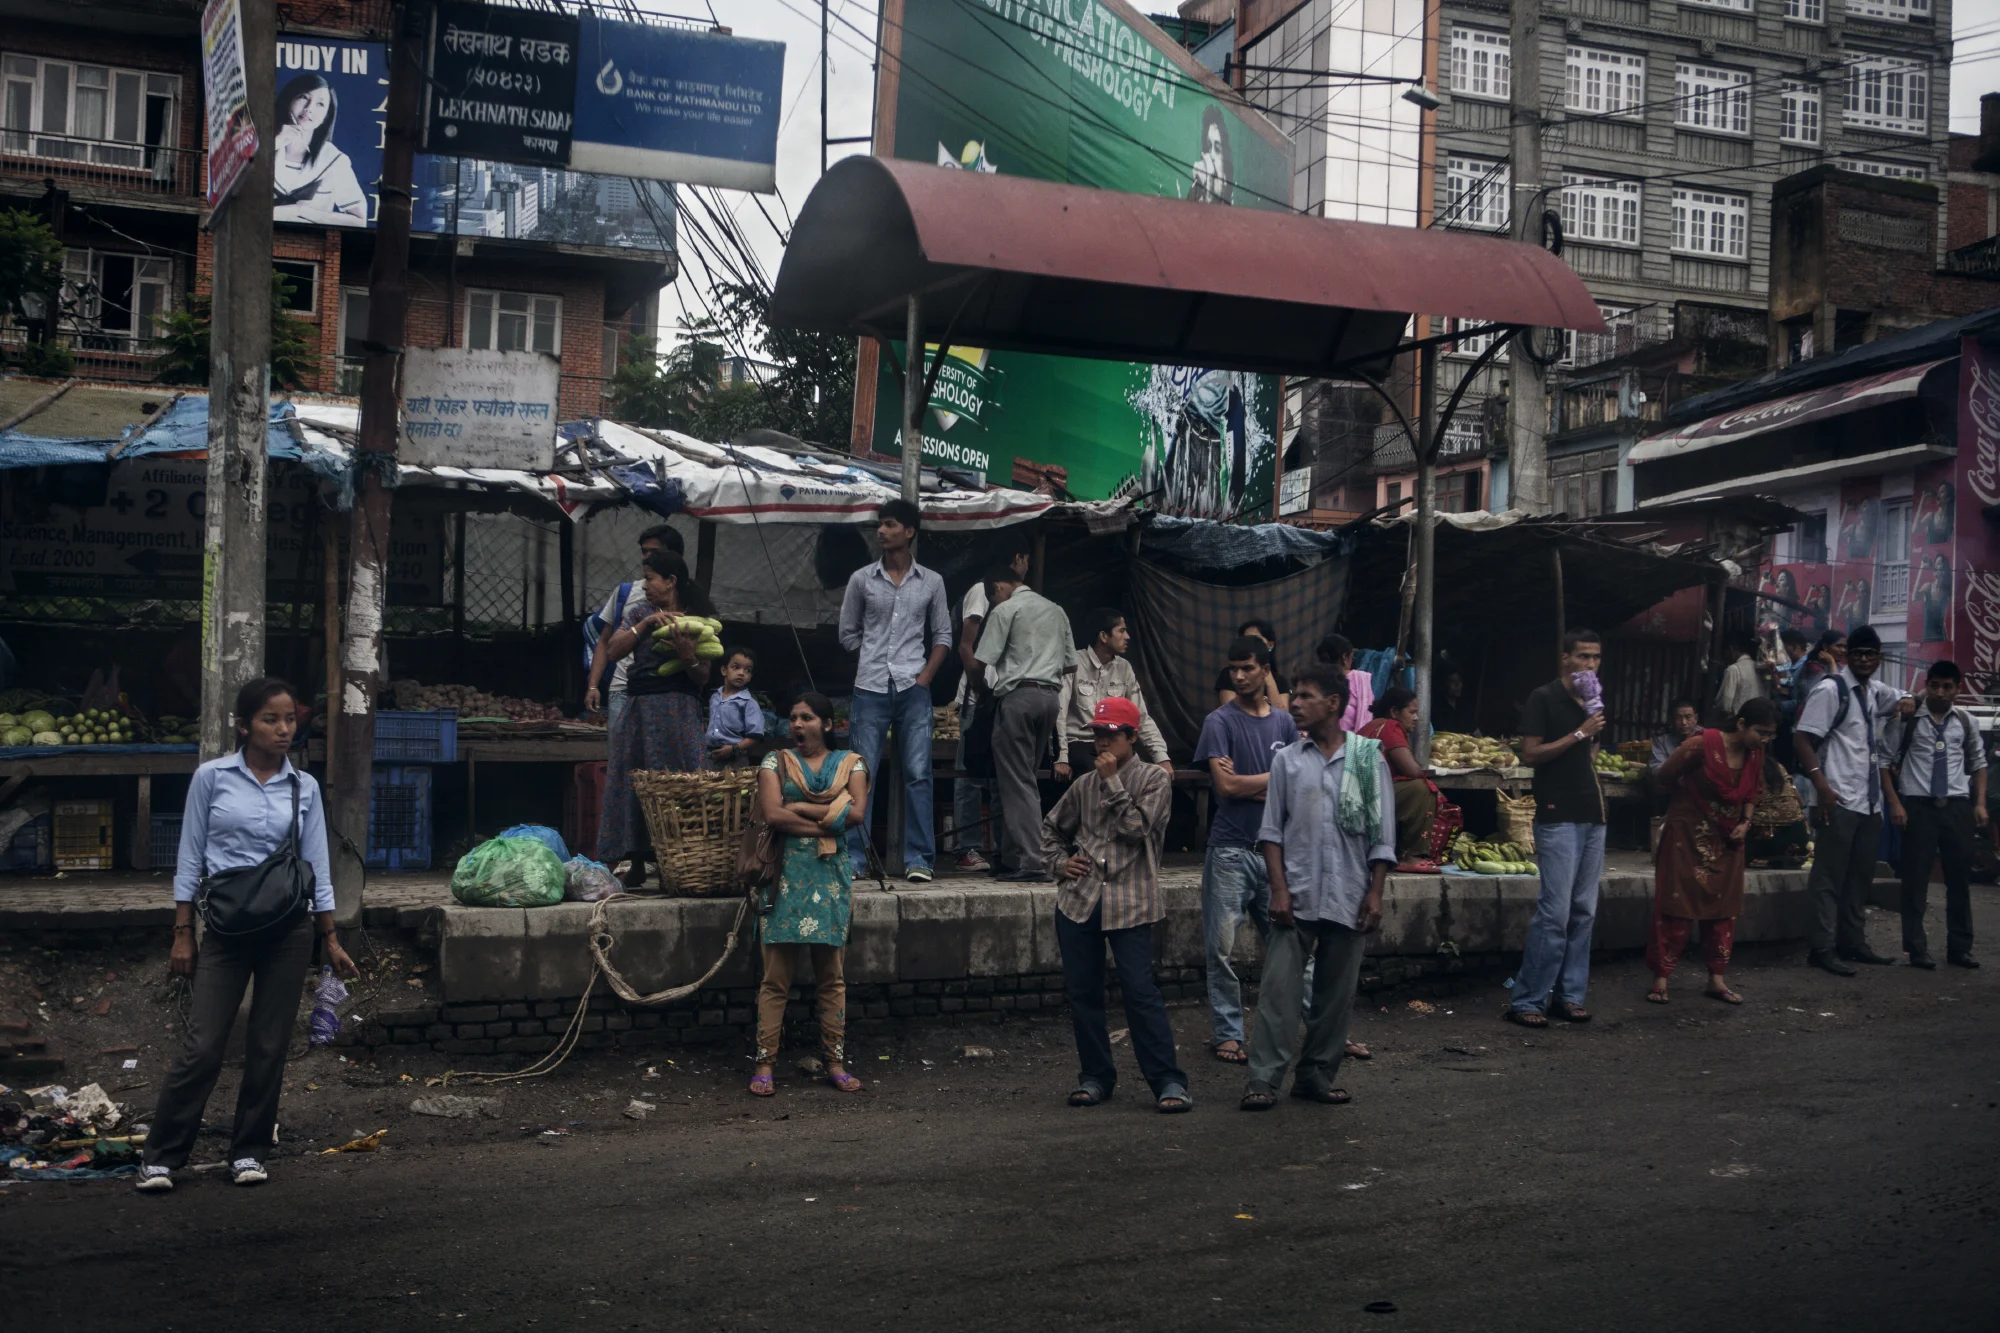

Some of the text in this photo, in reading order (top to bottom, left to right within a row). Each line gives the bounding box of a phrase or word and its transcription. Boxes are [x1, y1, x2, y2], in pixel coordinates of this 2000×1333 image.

[443, 22, 571, 67] लेखनाथ सडक
[341, 47, 368, 75] IN
[1029, 7, 1054, 48] OF
[1053, 25, 1153, 121] FRESHOLOGY
[1152, 57, 1181, 109] AT
[438, 97, 529, 128] LEKHNATH
[626, 87, 656, 101] BANK
[658, 93, 672, 103] OF
[675, 95, 740, 112] KATHMANDU
[634, 102, 754, 127] We make your life easier
[966, 375, 978, 390] OF
[961, 447, 990, 471] OPEN
[799, 487, 828, 496] PATAN
[72, 524, 192, 551] Management,
[52, 549, 96, 567] 2000
